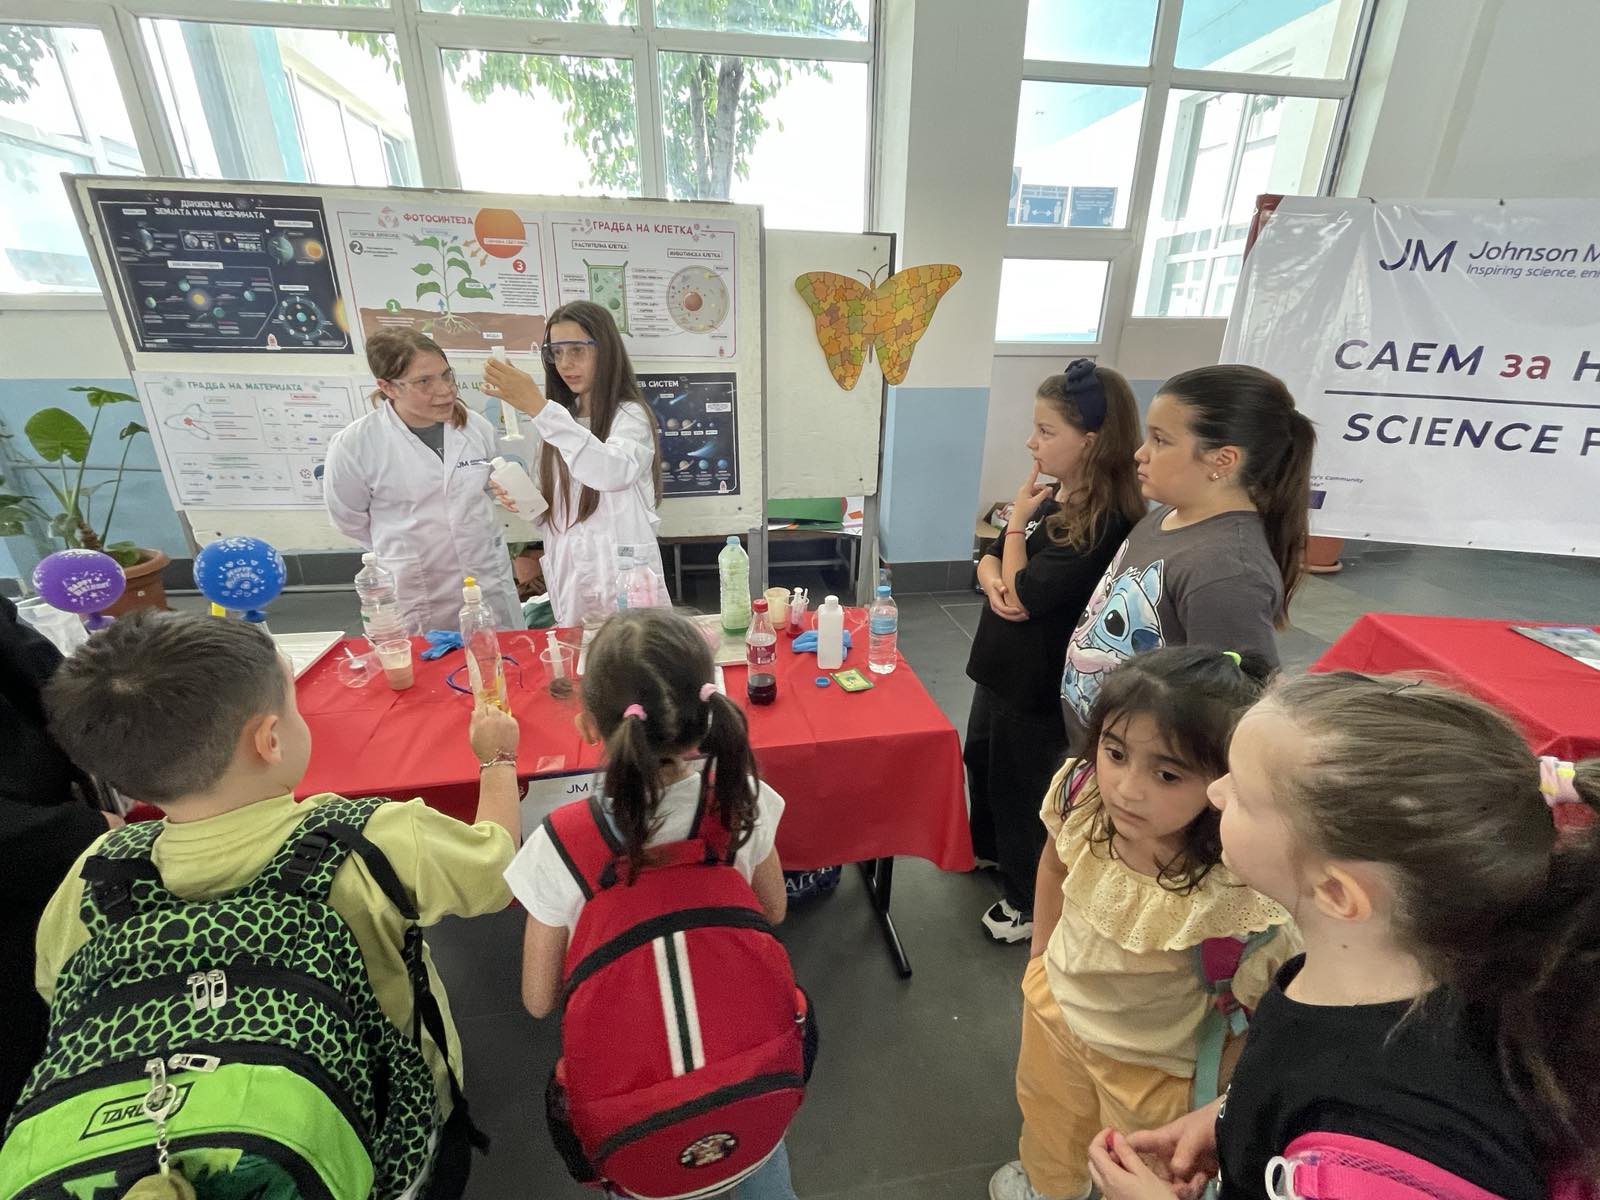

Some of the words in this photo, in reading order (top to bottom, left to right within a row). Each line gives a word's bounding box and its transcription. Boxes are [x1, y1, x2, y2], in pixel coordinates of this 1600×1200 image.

[221, 201, 234, 210] НА
[200, 209, 213, 217] НА
[402, 212, 474, 225] ФОТОСИНТЕЗА
[592, 220, 632, 233] ГРАДБА
[636, 223, 650, 233] НА
[654, 223, 693, 235] КЛЕТКА
[1379, 238, 1458, 273] JM
[1469, 240, 1578, 262] Johnson
[1466, 263, 1522, 279] Inspiring
[1525, 266, 1577, 278] science,
[187, 381, 226, 391] ГРАДБА
[228, 382, 242, 390] НА
[245, 383, 303, 391] МАТЕРИЈАТА
[648, 380, 679, 388] СИСТЕМ
[1342, 412, 1564, 455] SCIENCE
[566, 782, 589, 794] JM
